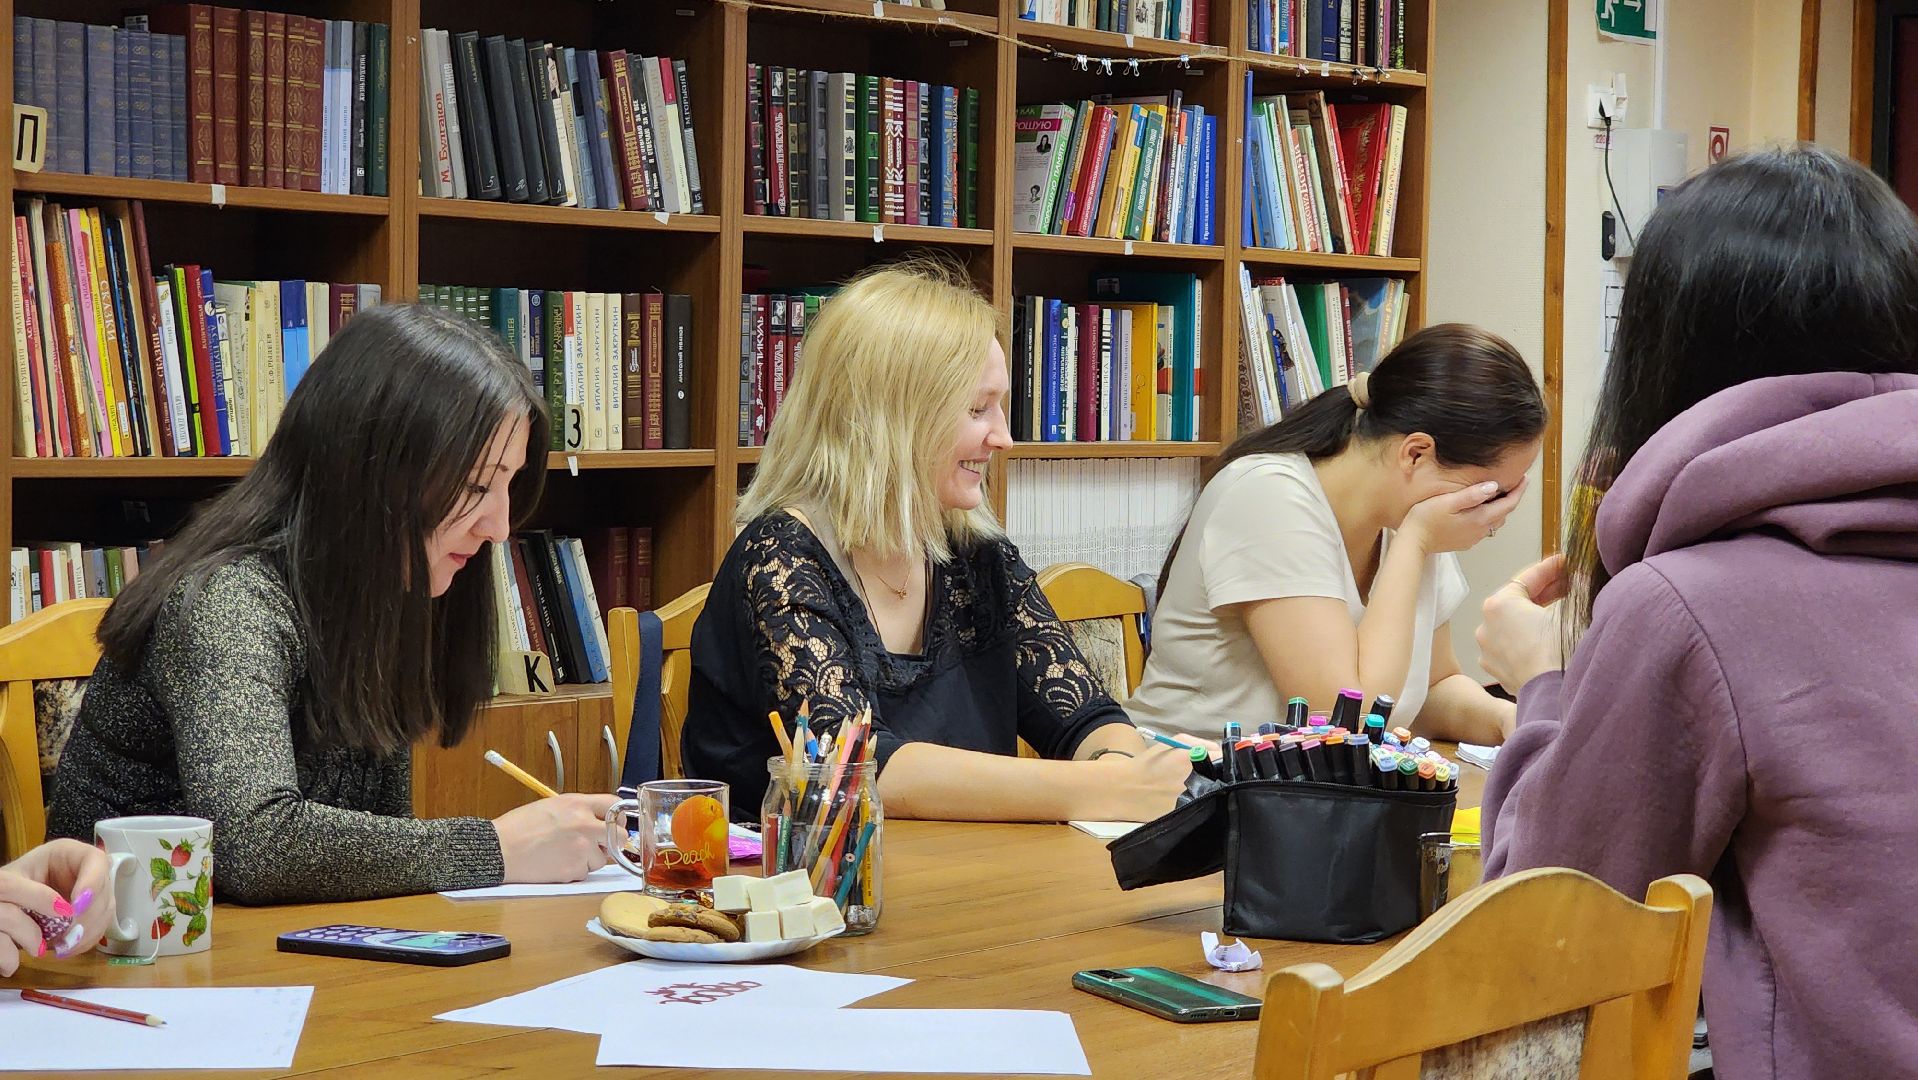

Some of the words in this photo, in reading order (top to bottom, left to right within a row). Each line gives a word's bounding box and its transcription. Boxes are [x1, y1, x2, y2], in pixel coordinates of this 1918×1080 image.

[441, 61, 458, 104] БУЛГАКОВ
[677, 73, 692, 125] М.ГОРЬКИЙ
[16, 113, 39, 163] П
[432, 92, 448, 162] Булгаков
[634, 112, 641, 122] ЗА
[636, 124, 646, 153] ОТВЕЧАЮ
[642, 115, 649, 125] ЗА
[643, 126, 654, 155] ОТВЕЧАЮ
[773, 111, 784, 163] ПИКУЛЬ
[439, 165, 451, 183] М.
[1040, 179, 1058, 229] ХОРОШУЮ
[1052, 139, 1066, 178] ПАМЯТЬ
[11, 278, 23, 334] МАЛЕНЬКИЕ
[22, 298, 33, 326] Пушкин
[98, 278, 117, 341] СКАЗКИ
[151, 331, 165, 378] СКАЗКИ
[574, 303, 583, 358] ЗАКРУТКИН
[755, 315, 765, 365] ПИКУЛЬ
[210, 344, 225, 397] ПУШКИН
[773, 339, 783, 391] ПИКУЛЬ
[1101, 361, 1109, 416] ЭСТЕТИКА
[109, 403, 118, 431] СКАЗКИ
[567, 408, 582, 449] З
[523, 654, 550, 693] К
[657, 841, 716, 870] Peach
